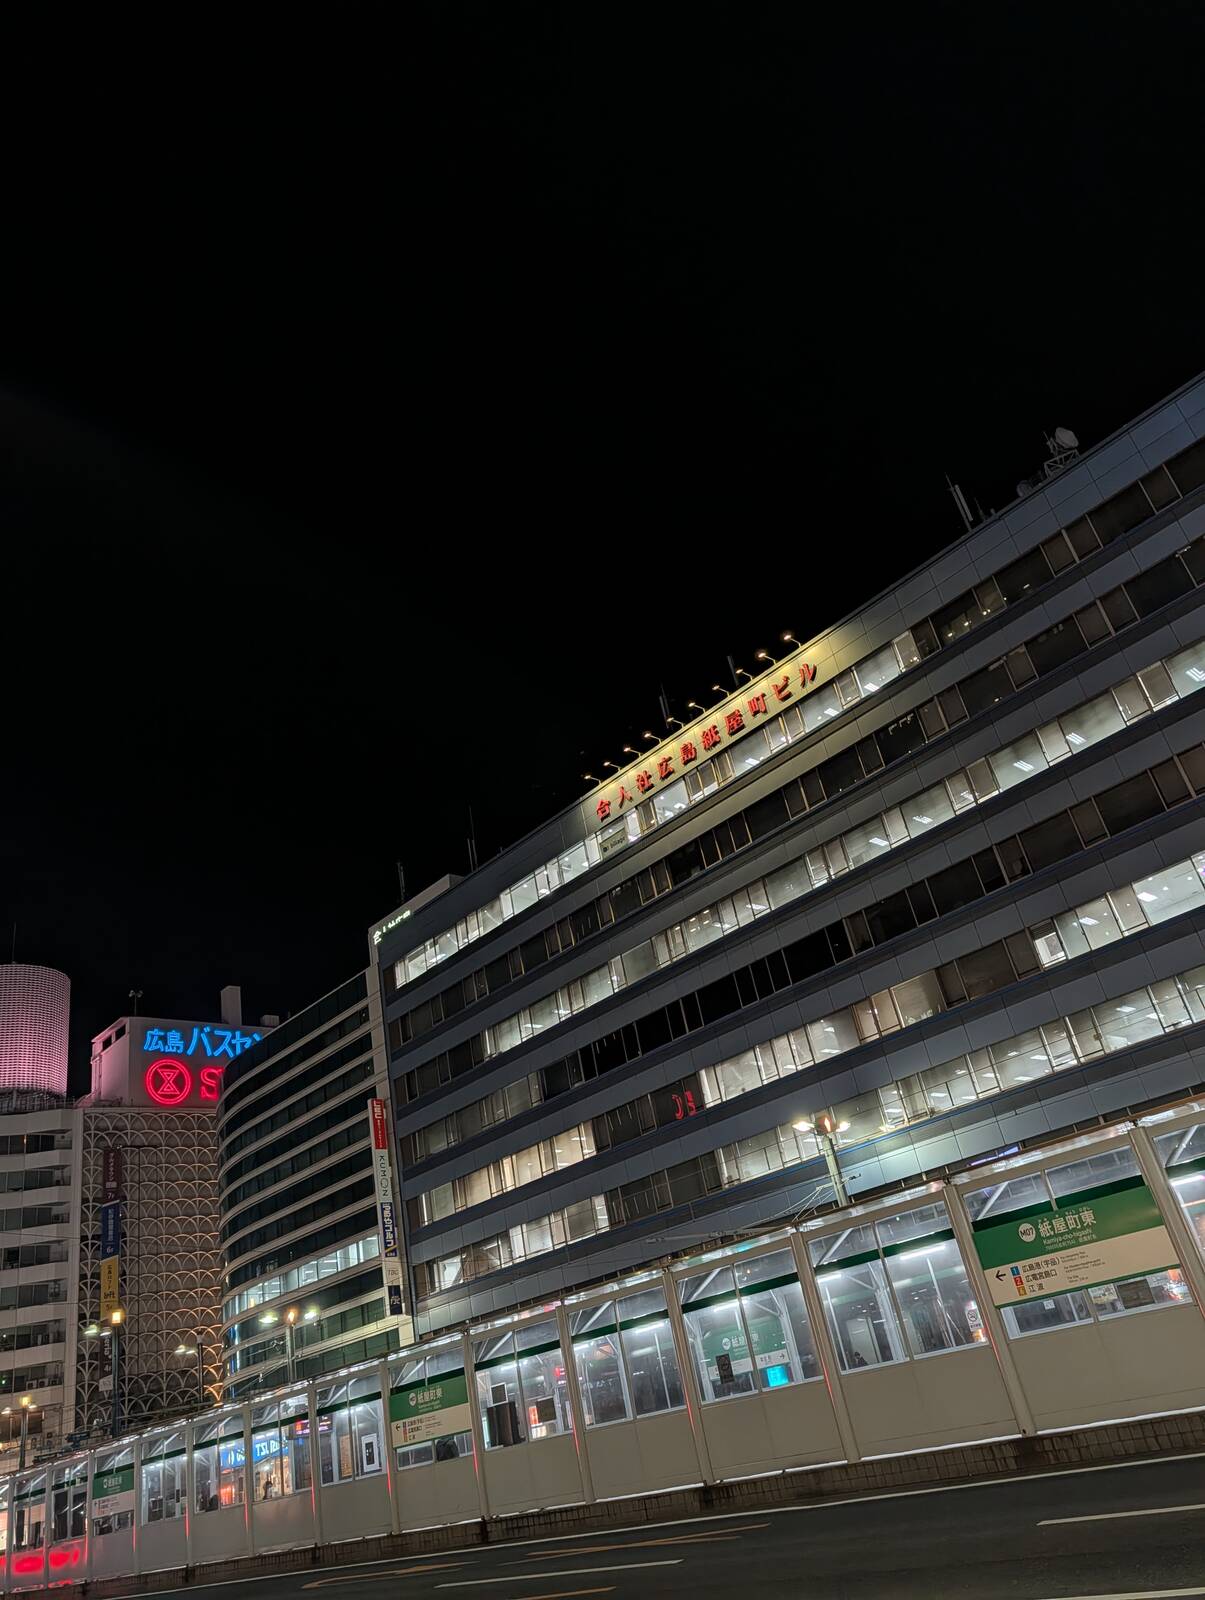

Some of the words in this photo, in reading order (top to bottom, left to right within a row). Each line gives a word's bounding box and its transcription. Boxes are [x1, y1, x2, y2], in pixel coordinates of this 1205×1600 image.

[597, 663, 817, 821] 合人社広島紙屋町ビル
[143, 1027, 262, 1058] 広島バスセ
[380, 1156, 389, 1196] KUMON
[1020, 1227, 1034, 1237] M07
[1038, 1210, 1096, 1237] 紙屋町東
